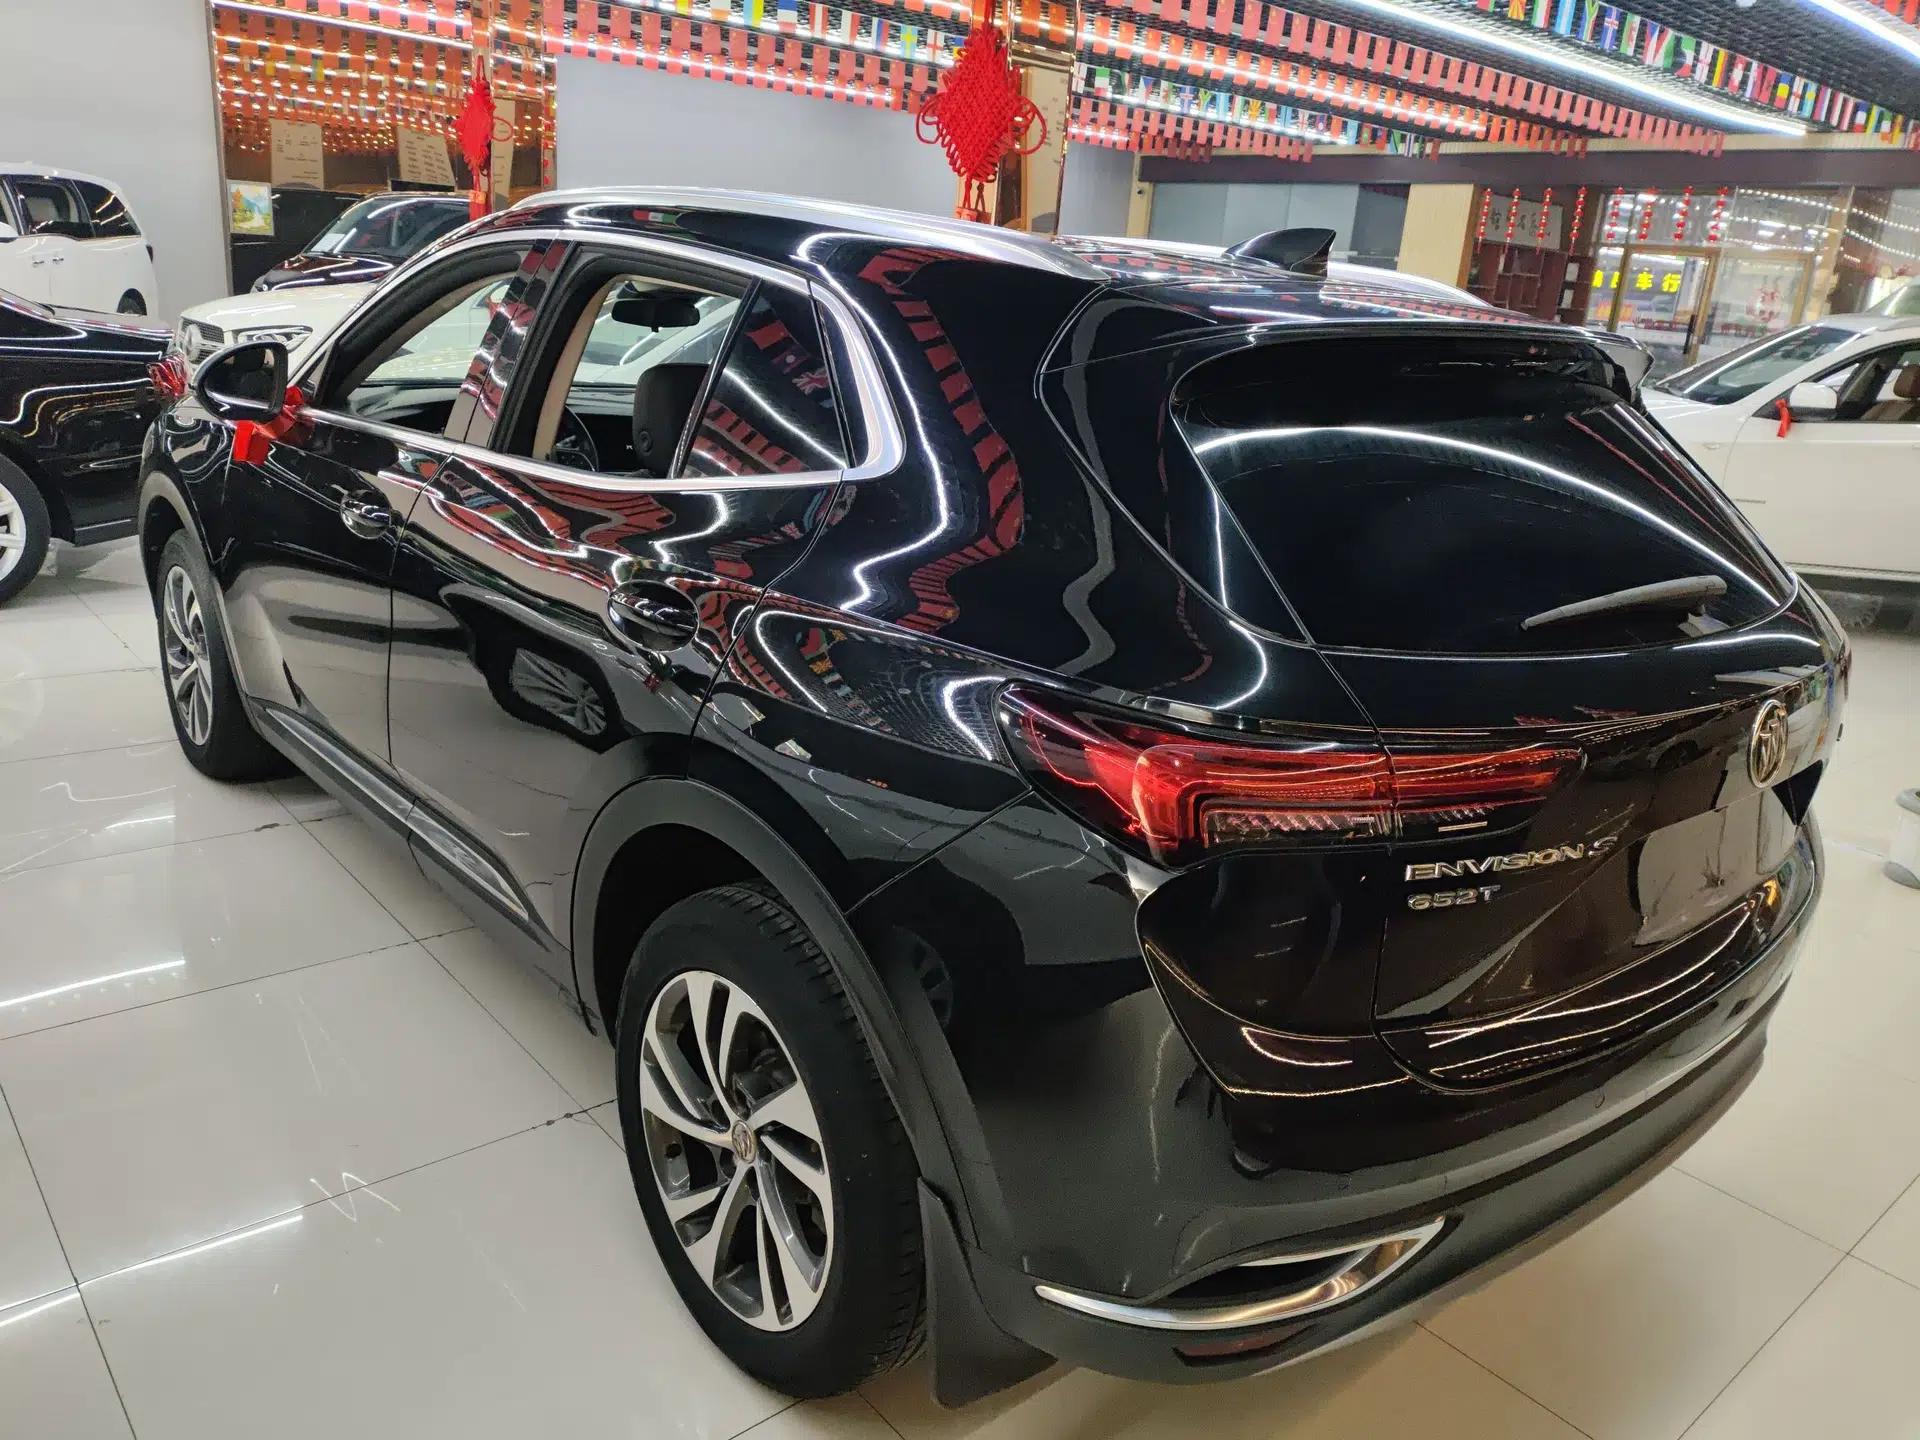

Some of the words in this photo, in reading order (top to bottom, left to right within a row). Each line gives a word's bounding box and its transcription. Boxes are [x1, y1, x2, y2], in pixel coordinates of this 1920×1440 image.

[1404, 843, 1584, 881] ENVISION
[1588, 836, 1618, 857] S
[1408, 884, 1501, 911] 652T
